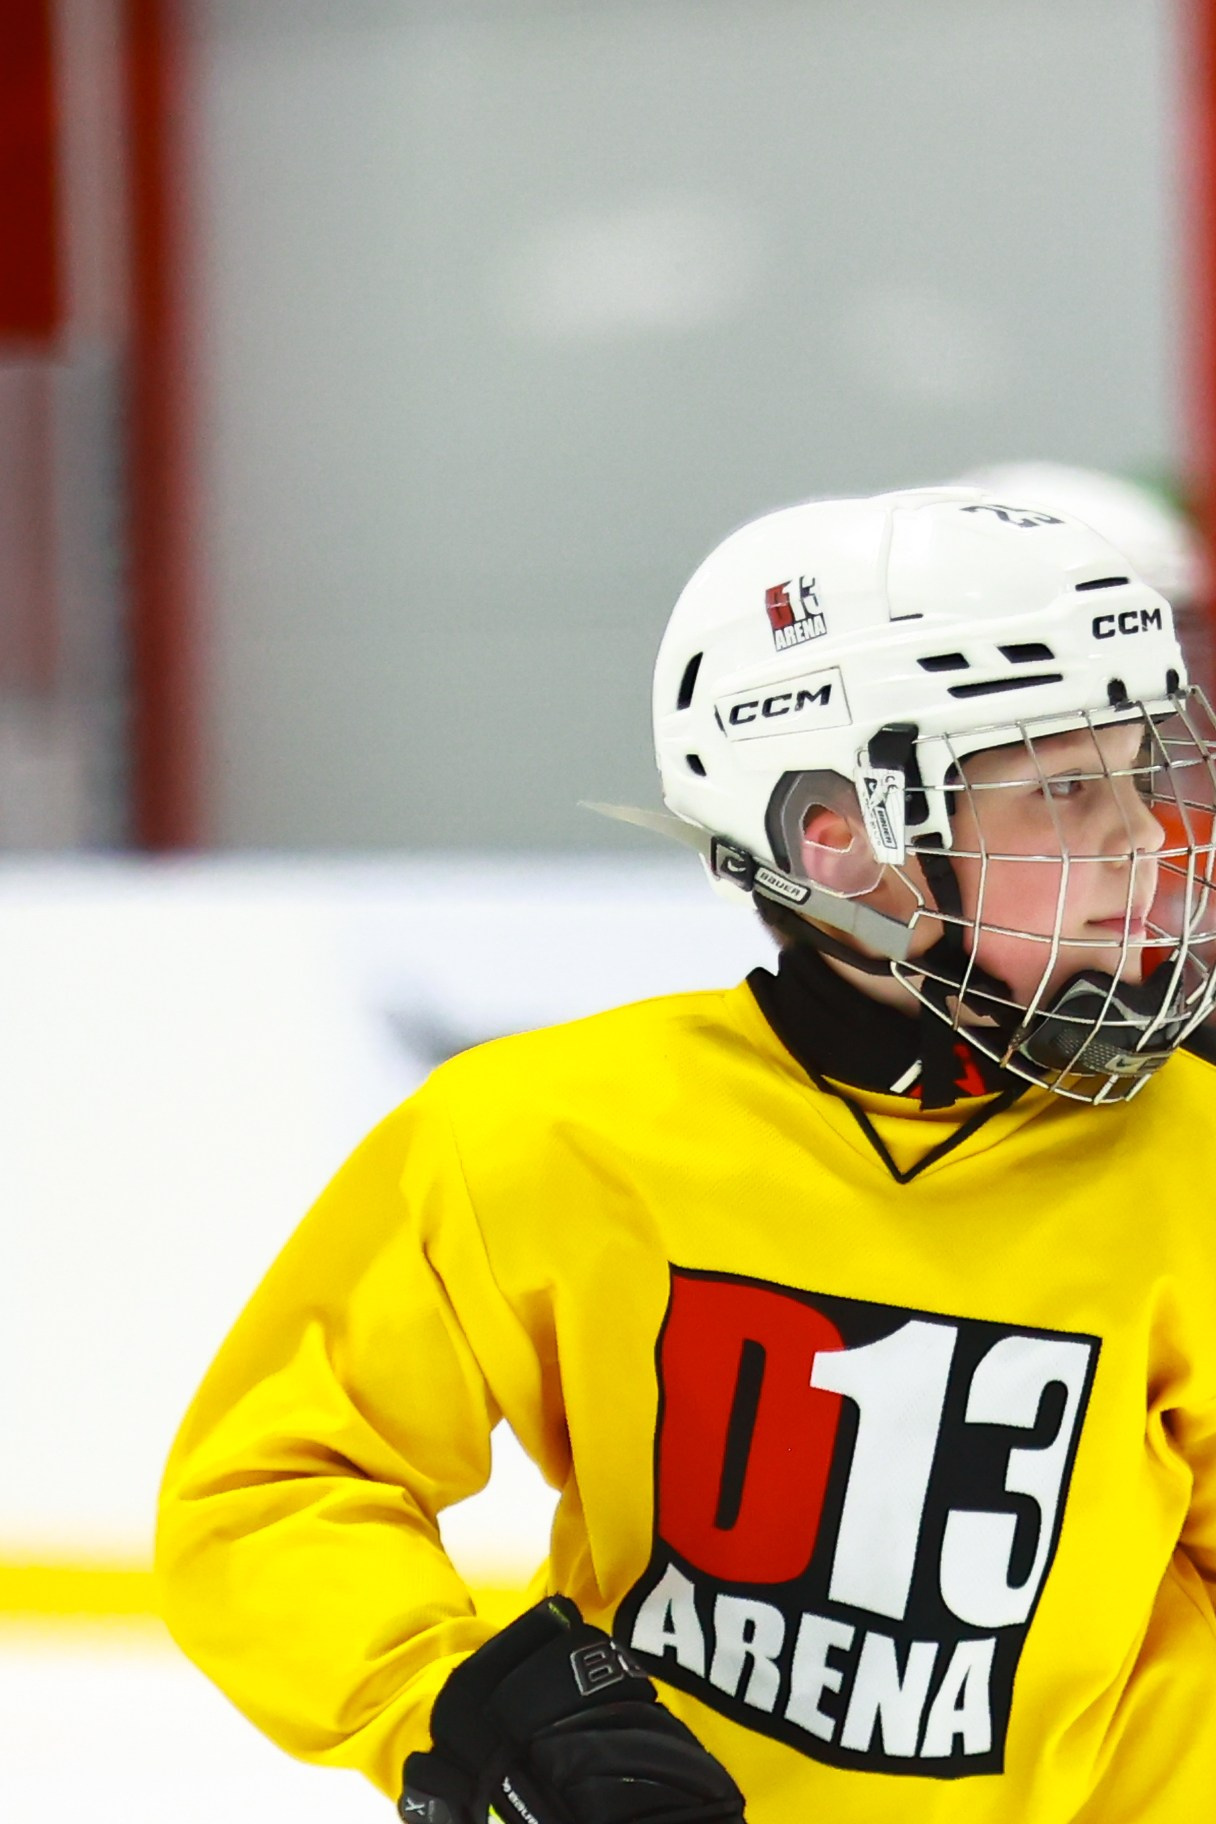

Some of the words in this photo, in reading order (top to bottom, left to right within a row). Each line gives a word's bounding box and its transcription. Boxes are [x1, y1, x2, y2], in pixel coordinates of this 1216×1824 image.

[764, 574, 824, 630] D13
[1091, 607, 1163, 640] CCM
[774, 614, 827, 650] ARENA
[728, 683, 832, 726] CCM
[759, 871, 802, 897] BAUER
[658, 1273, 1093, 1630] D13
[629, 1561, 998, 1759] ARENA
